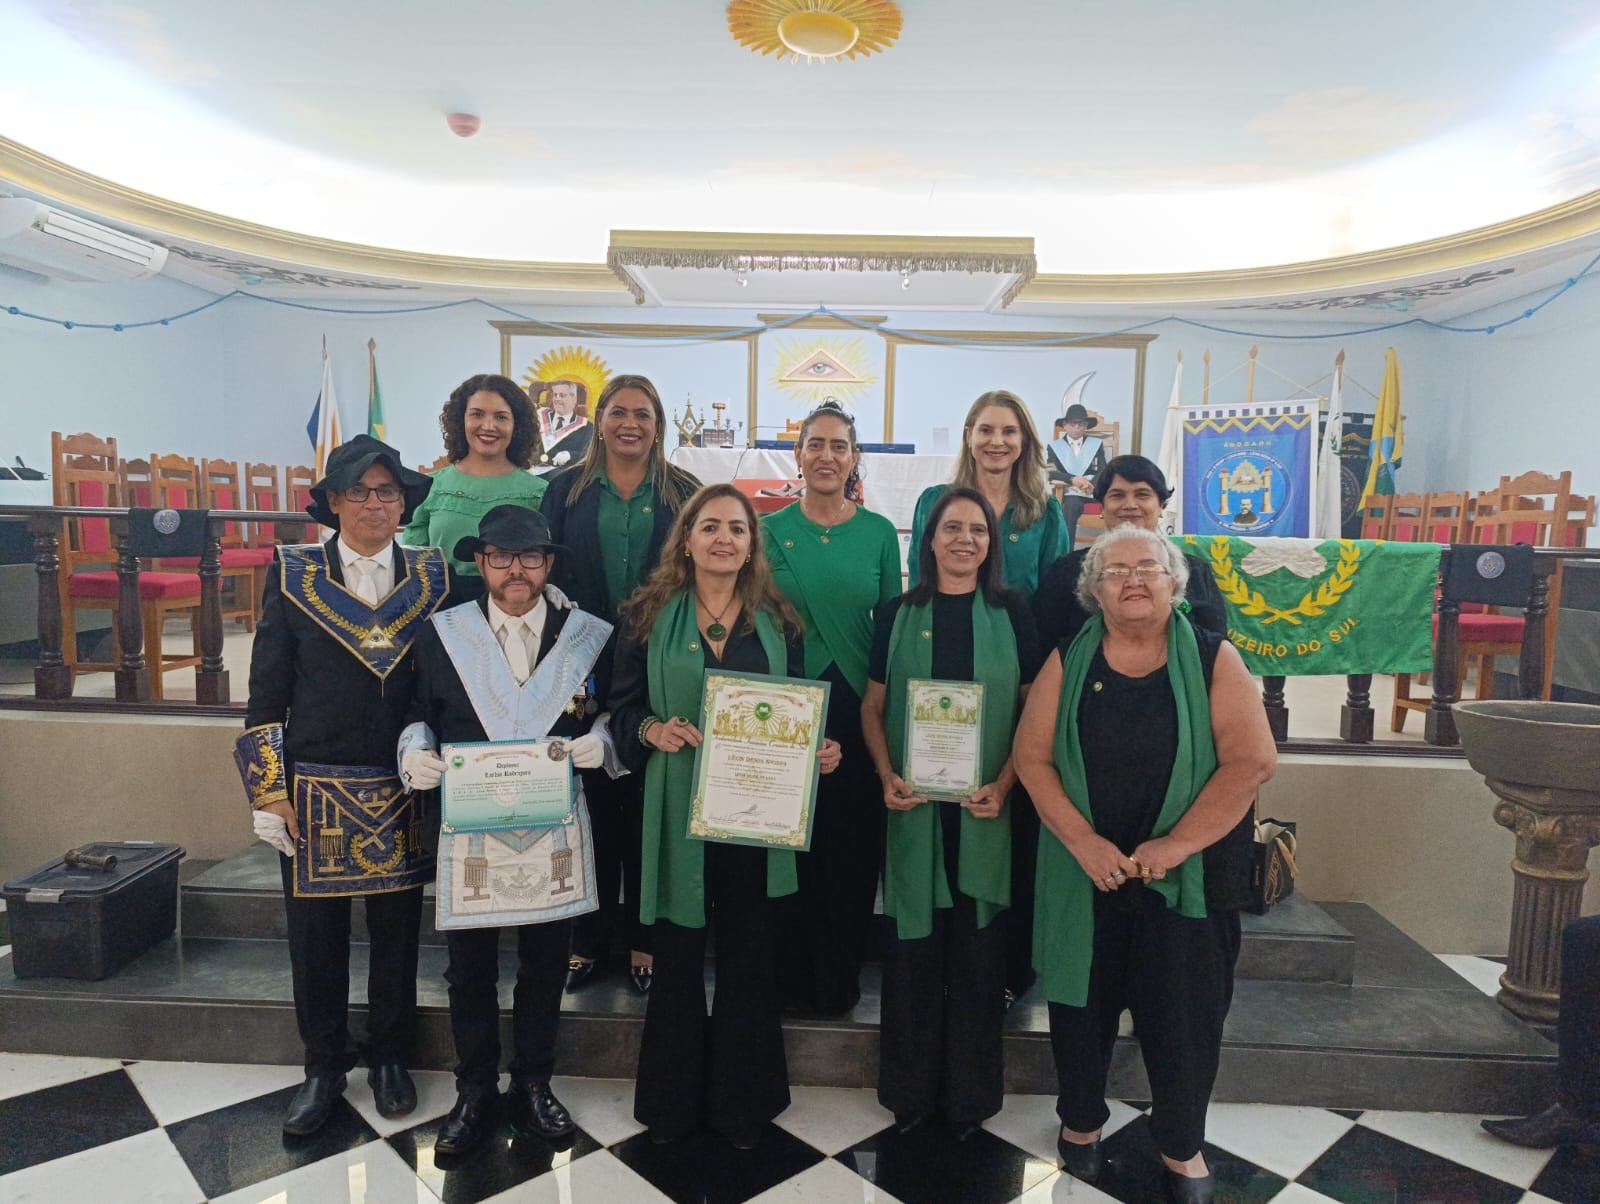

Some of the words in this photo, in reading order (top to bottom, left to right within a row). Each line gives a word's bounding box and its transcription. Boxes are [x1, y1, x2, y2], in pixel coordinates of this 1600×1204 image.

[1227, 629, 1289, 658] UZEIRO
[1297, 639, 1321, 656] DO
[1328, 618, 1360, 643] SUL
